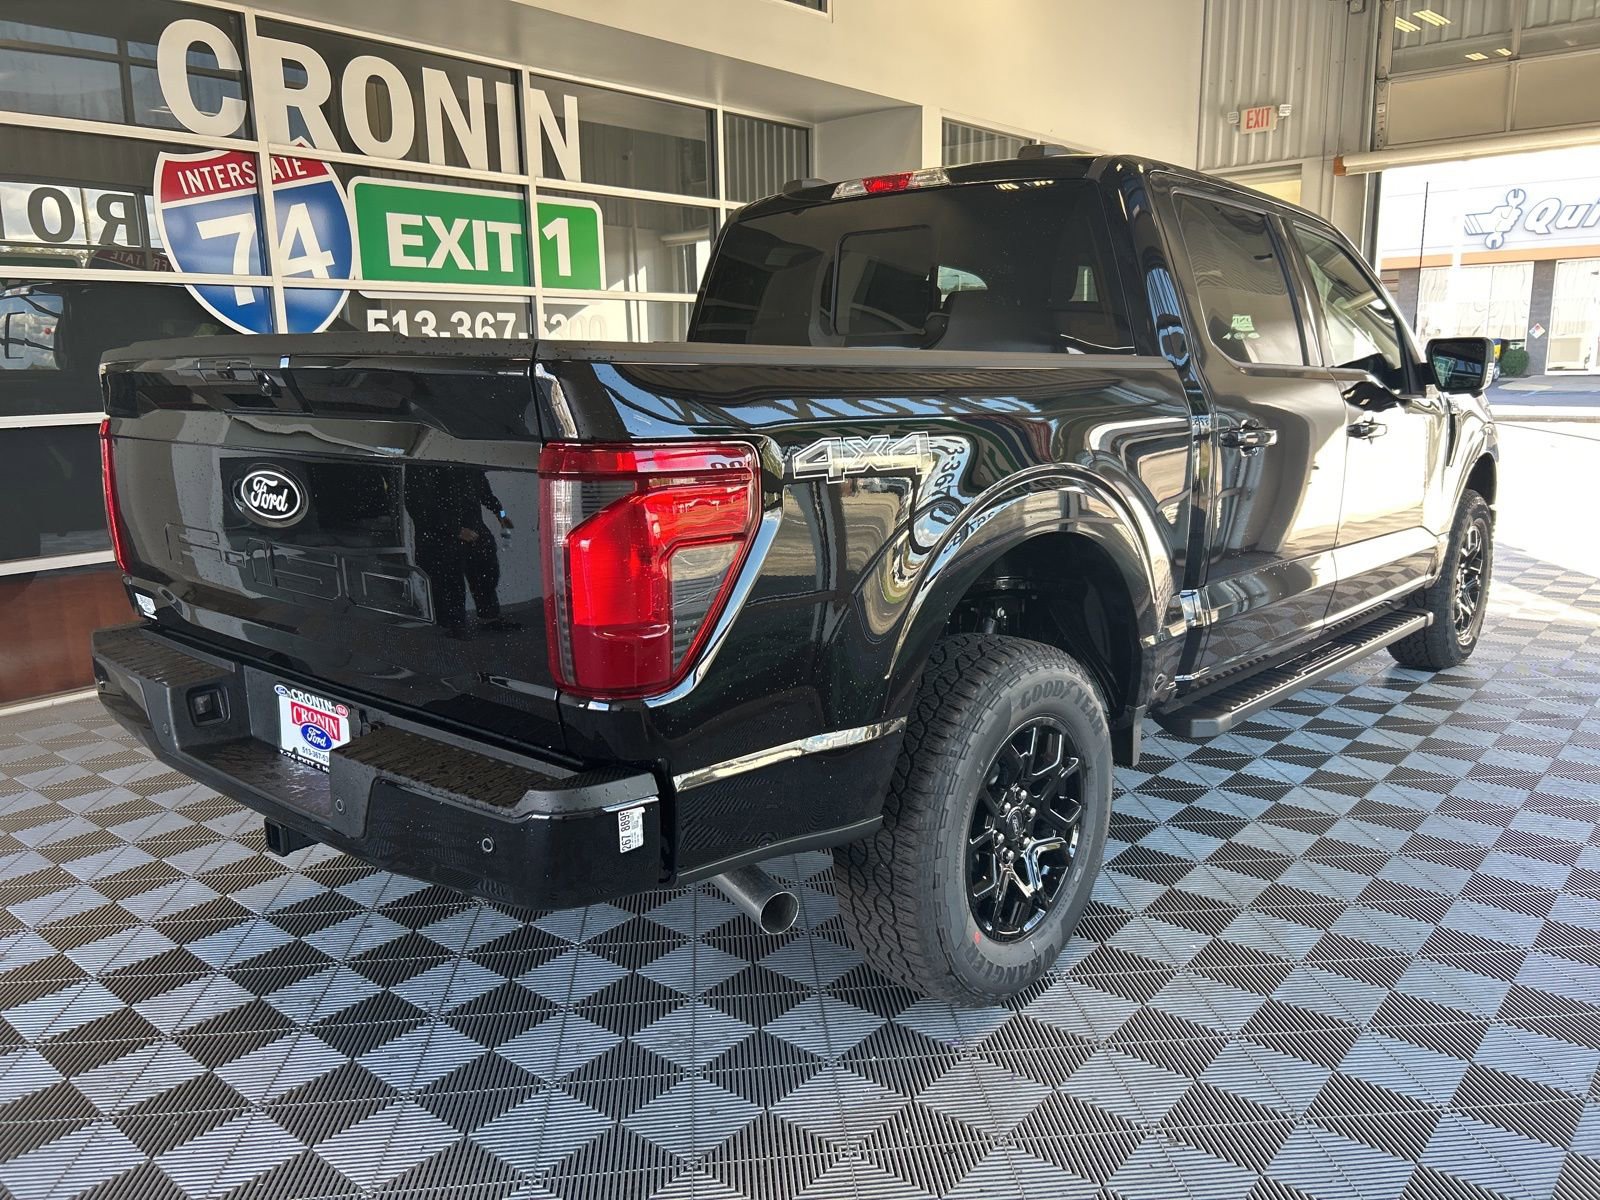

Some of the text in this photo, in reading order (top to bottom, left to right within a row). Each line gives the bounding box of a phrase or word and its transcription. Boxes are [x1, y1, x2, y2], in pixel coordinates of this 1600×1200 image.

[157, 19, 581, 182] CRONIN
[1246, 107, 1272, 129] EXIT
[177, 157, 308, 195] INTERSATE
[196, 203, 336, 306] 74
[386, 212, 572, 277] EXIT 1
[250, 476, 289, 512] Ford
[291, 688, 333, 712] CRONIN
[293, 705, 339, 741] CRONIN
[306, 726, 328, 748] Ford
[621, 835, 632, 852] 267
